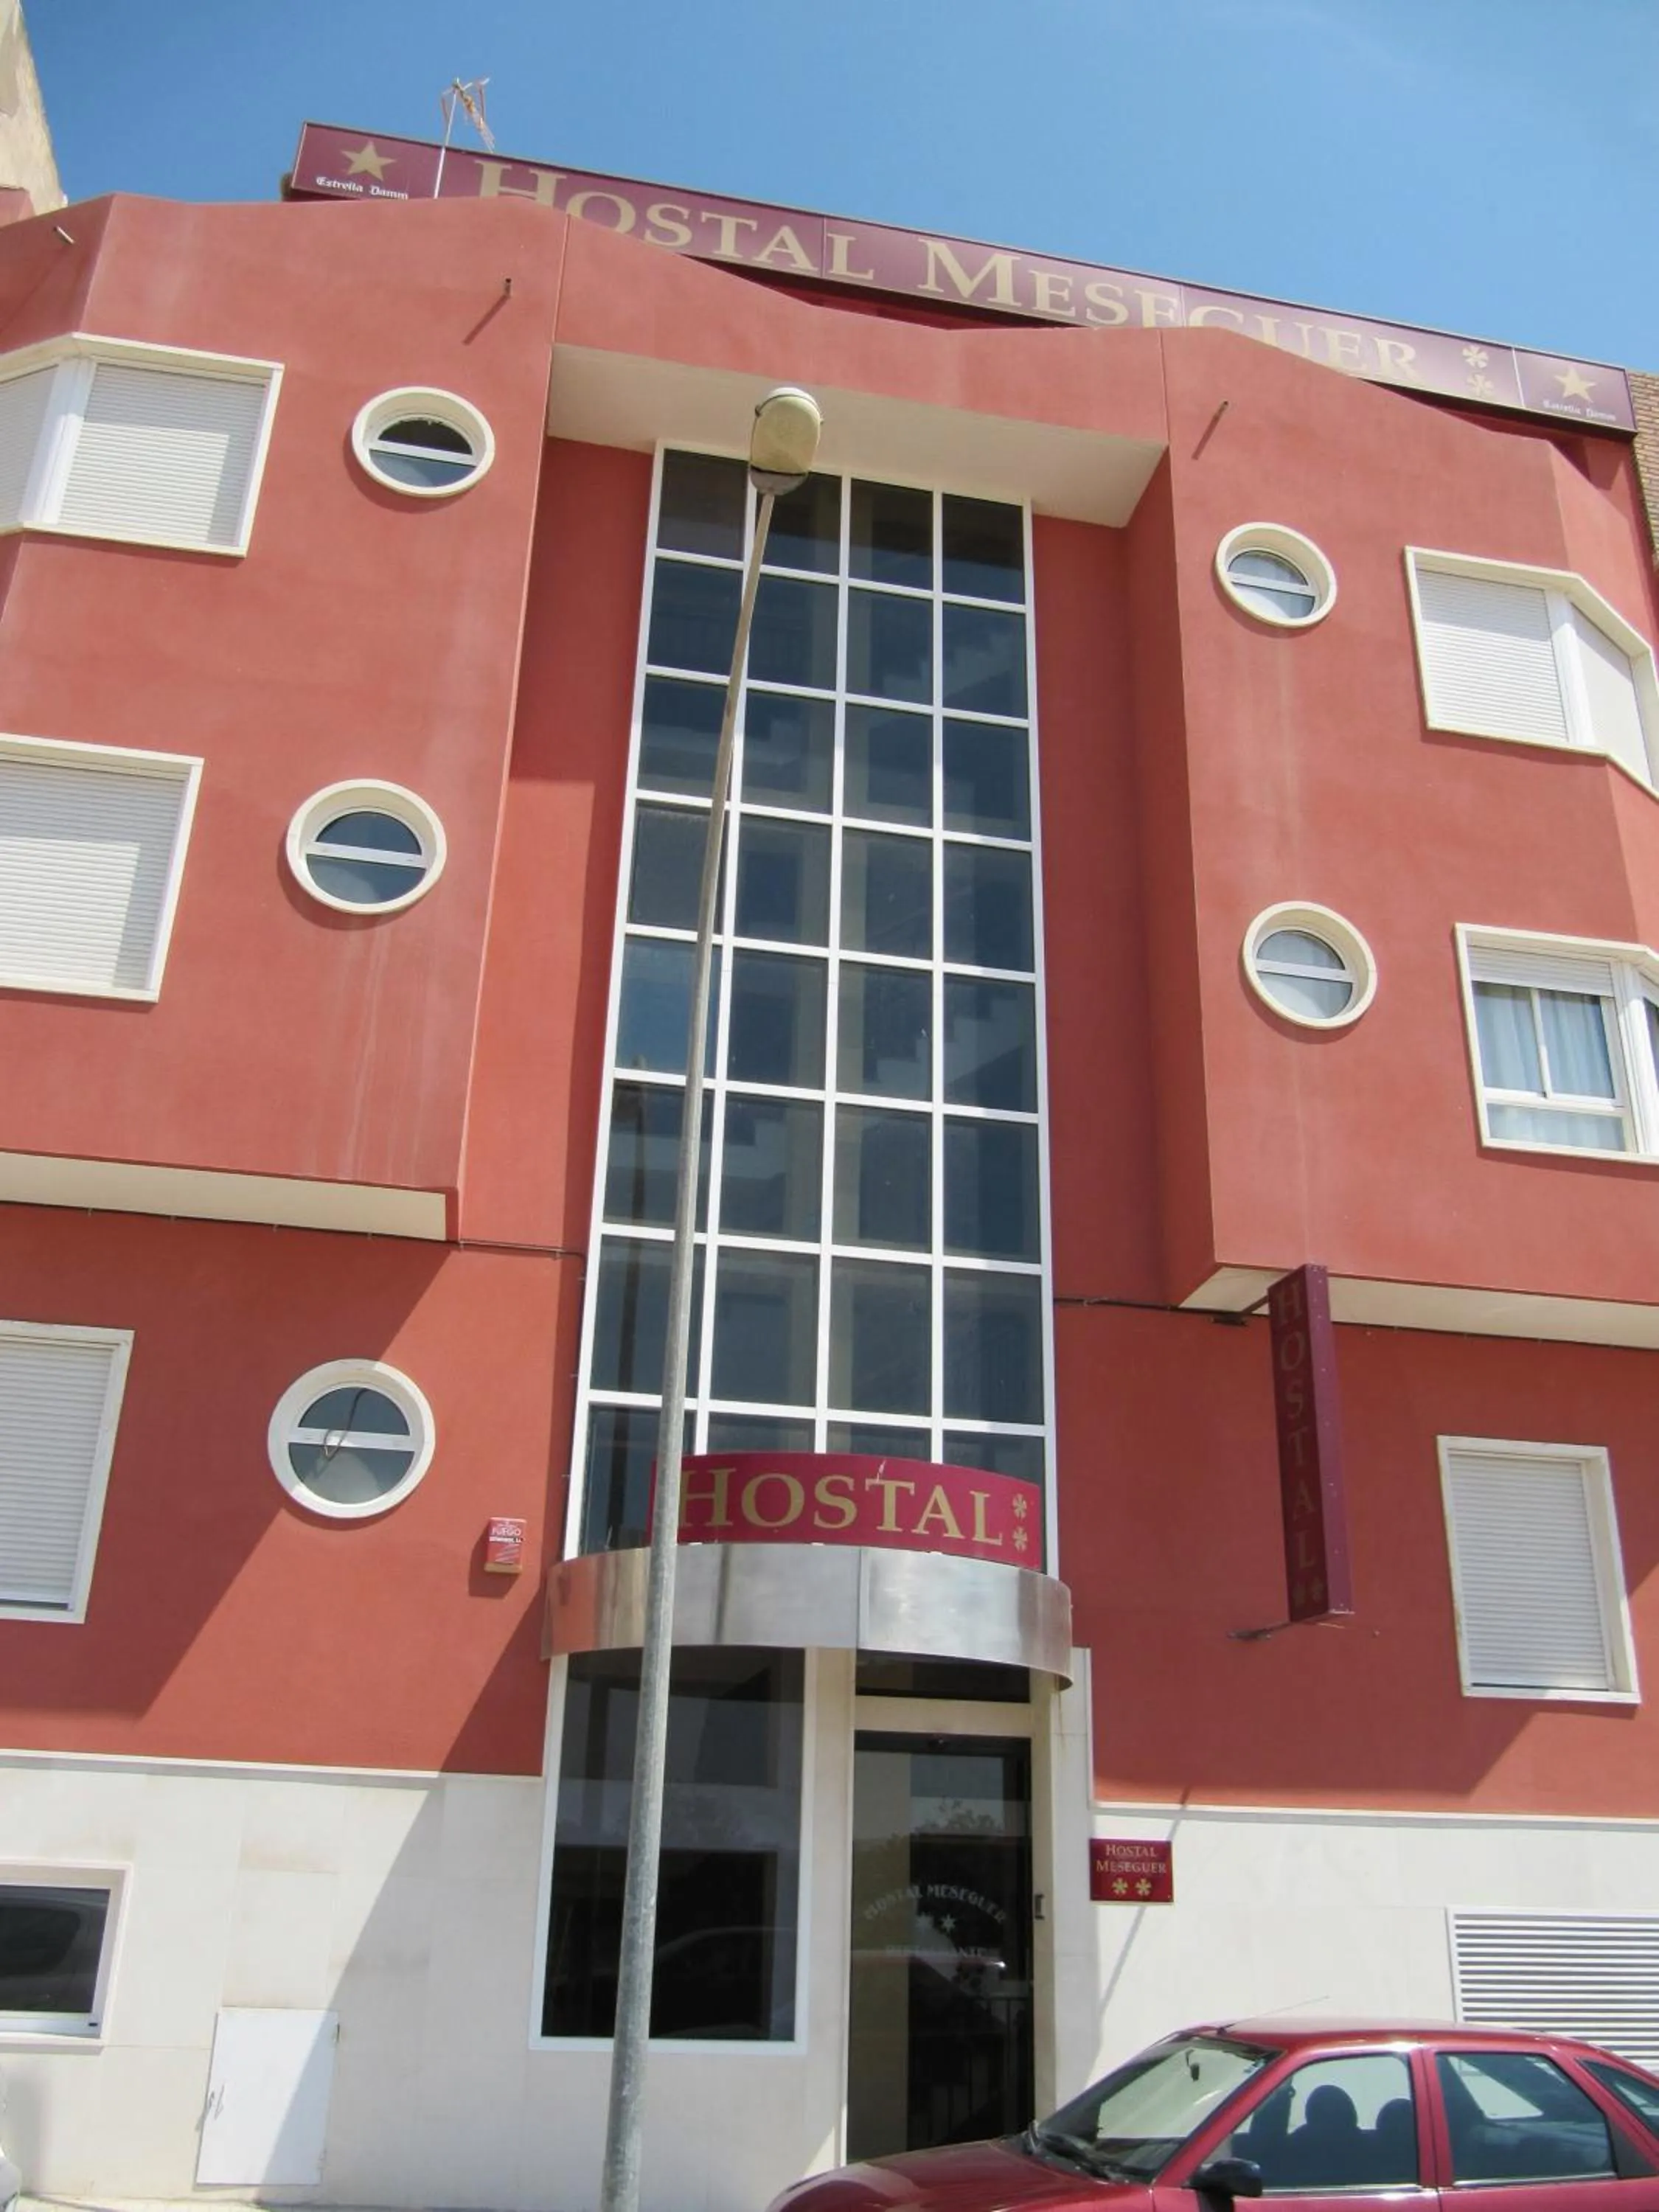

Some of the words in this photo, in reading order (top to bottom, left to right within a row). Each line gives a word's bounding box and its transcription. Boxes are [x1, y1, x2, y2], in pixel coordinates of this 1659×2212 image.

[316, 176, 364, 193] Estrella
[370, 185, 409, 201] Damm
[473, 159, 874, 280] HOSTAL
[1276, 1281, 1316, 1570] HOSTAL
[678, 1467, 1003, 1547] HOSTAL
[1096, 1860, 1166, 1874] MESEGUER
[1105, 1844, 1158, 1857] HOSTAL
